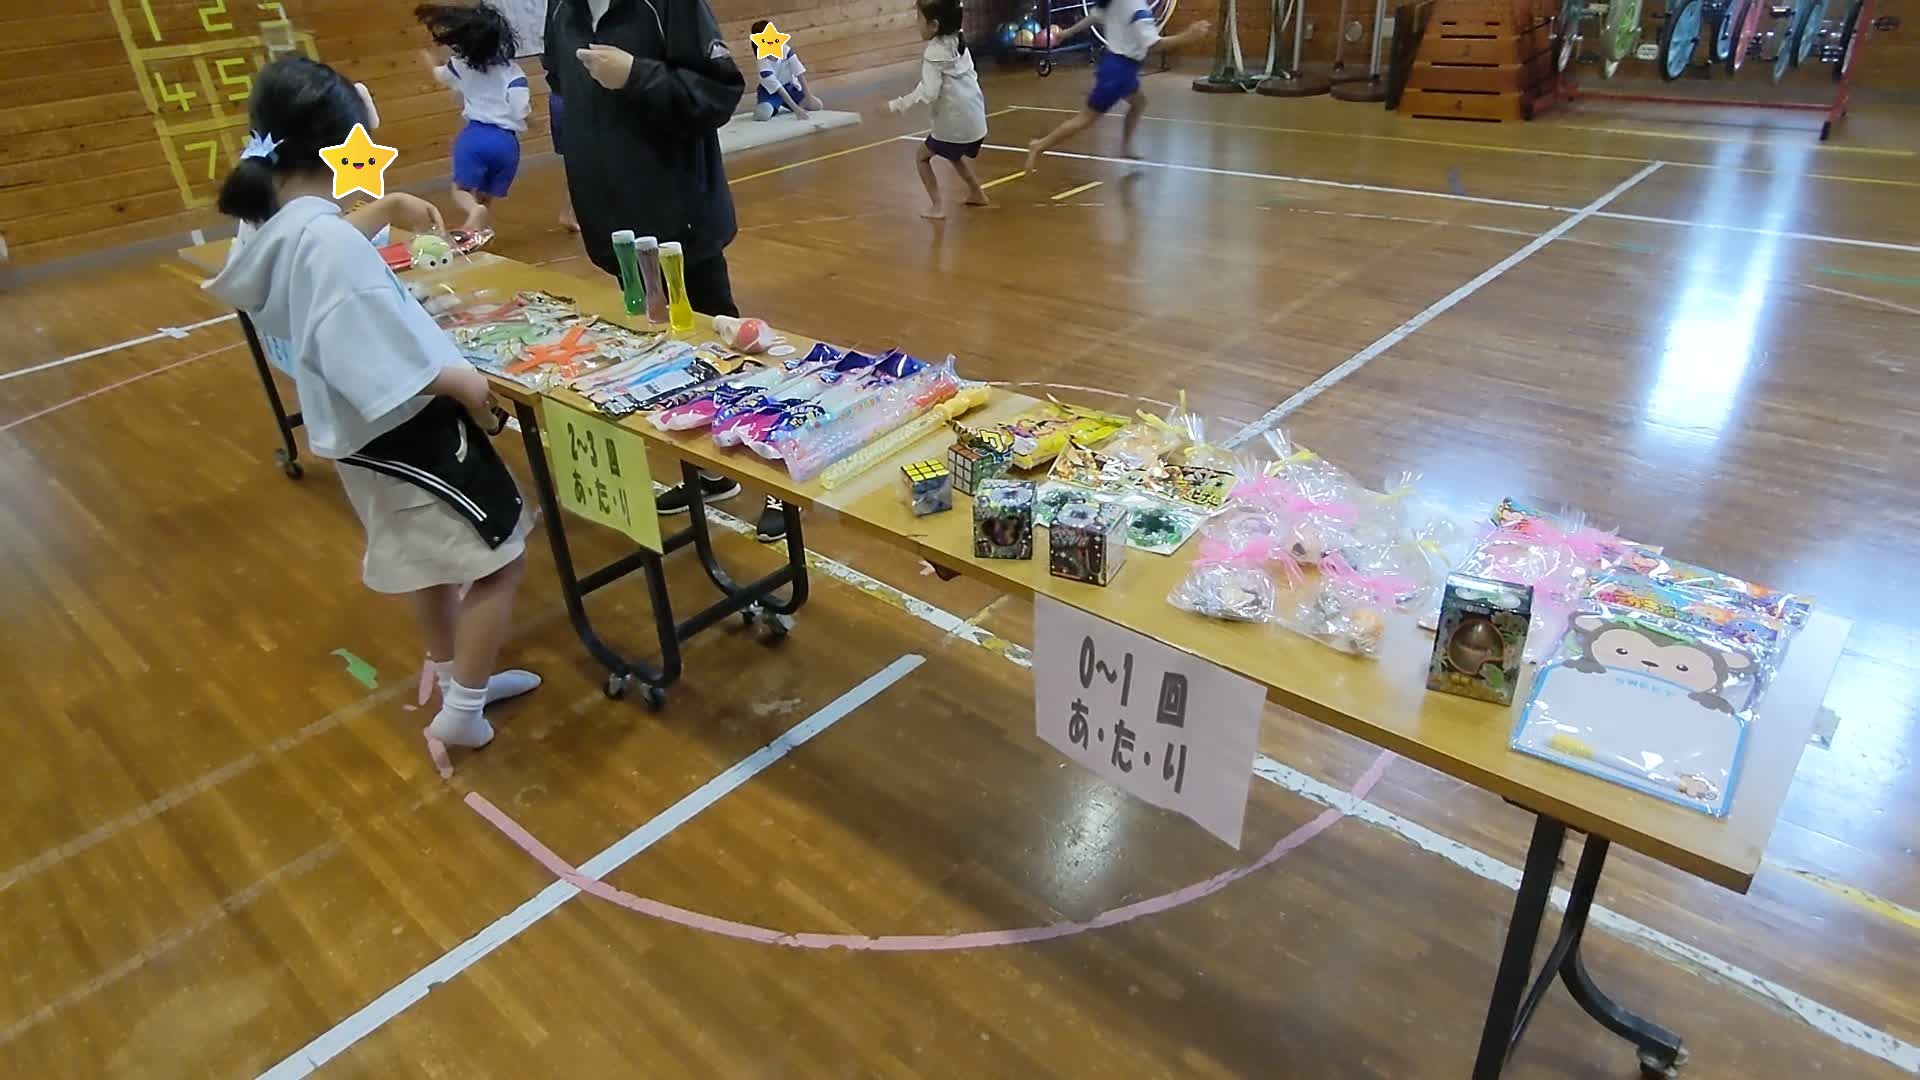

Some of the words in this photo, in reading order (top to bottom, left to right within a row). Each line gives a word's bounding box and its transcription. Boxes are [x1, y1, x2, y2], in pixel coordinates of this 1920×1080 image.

[140, 0, 162, 41] 1
[199, 0, 232, 31] 2
[154, 72, 197, 112] 4
[216, 58, 252, 101] 5
[185, 140, 217, 179] 7
